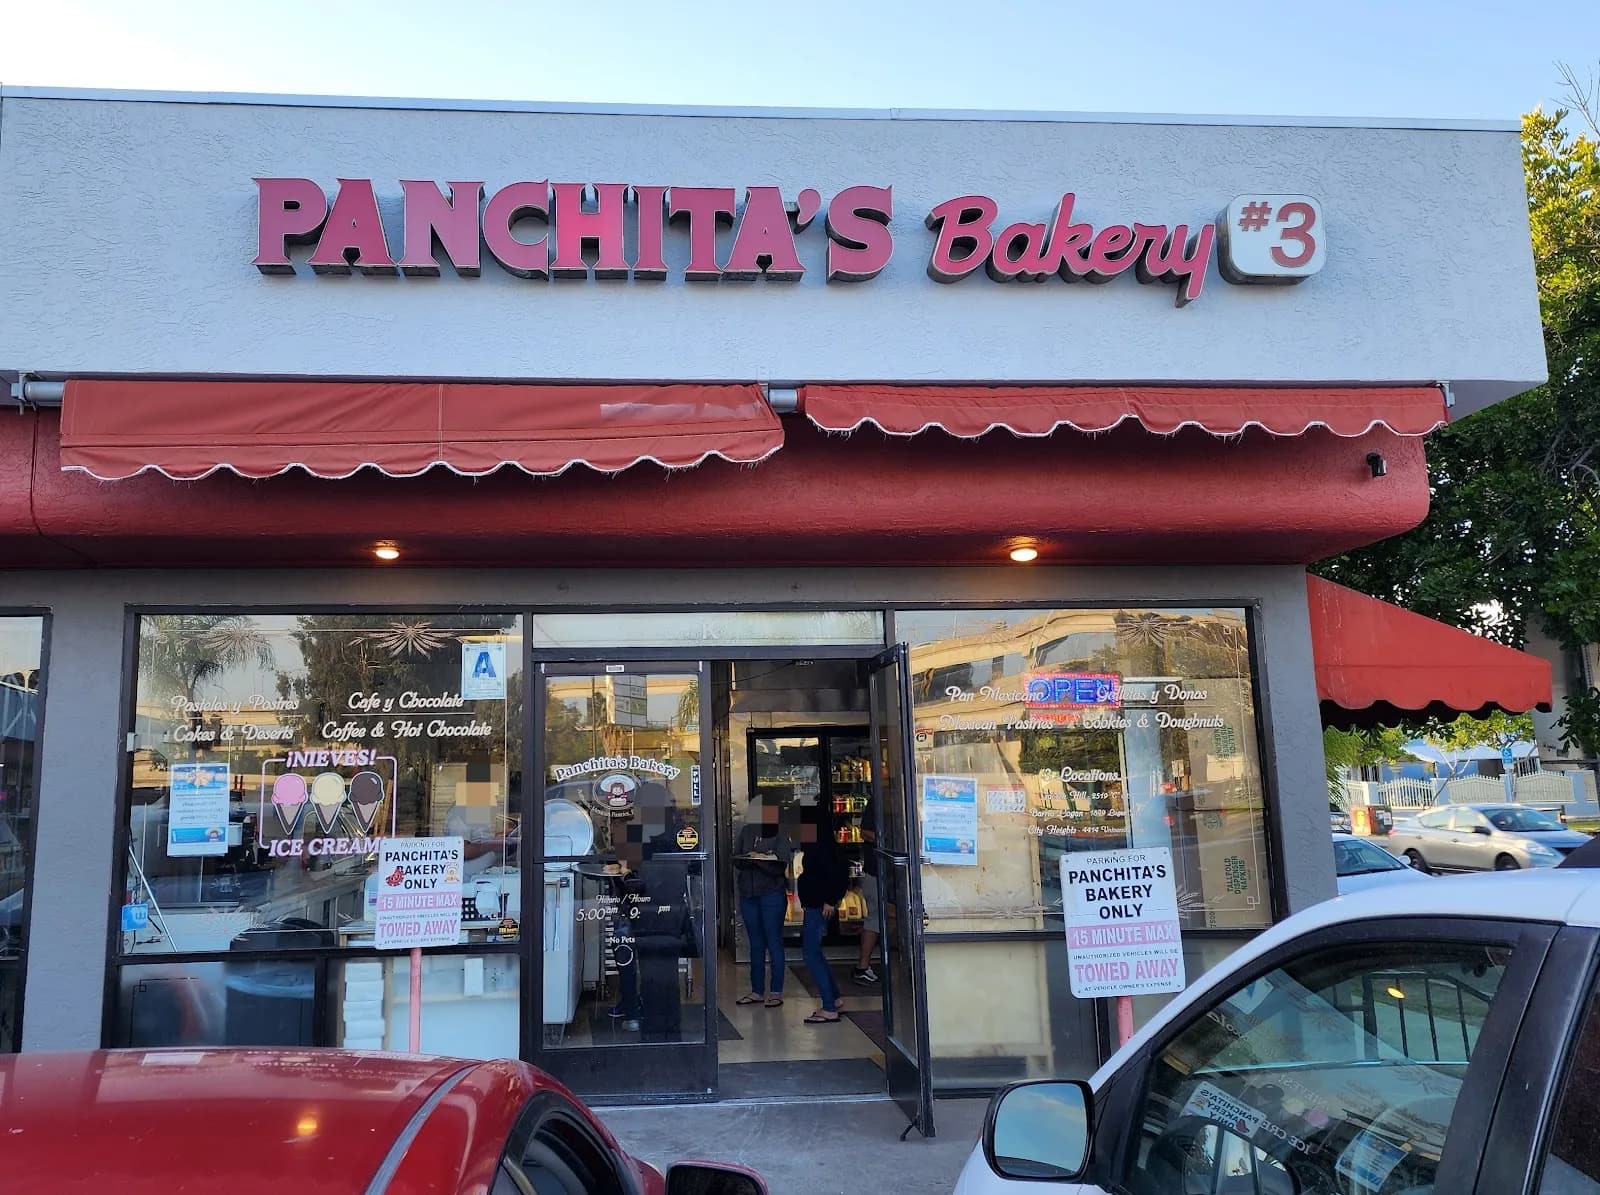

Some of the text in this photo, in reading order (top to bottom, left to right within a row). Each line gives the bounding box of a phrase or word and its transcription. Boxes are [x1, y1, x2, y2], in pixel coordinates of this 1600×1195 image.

[251, 178, 1318, 305] PANCHITA'S Bakery #3
[471, 651, 497, 679] A
[945, 685, 1045, 702] Pan Mexicano
[1029, 677, 1116, 703] OPEN
[1096, 684, 1208, 704] Galletas y Donas
[171, 694, 300, 715] Pasteles y Postres
[348, 691, 464, 713] Cafe y Chocolate
[322, 719, 492, 742] Coffee & Hot Chocolate
[940, 715, 997, 730] Mexican
[1083, 713, 1132, 729] Cookies
[1137, 713, 1149, 728] &
[1155, 712, 1225, 731] Doughnuts
[174, 725, 216, 742] Cakes
[220, 726, 235, 741] &
[286, 749, 377, 768] ¡NIEVES!
[555, 755, 681, 782] Panchita's Bakery
[1060, 766, 1121, 782] Locations
[1057, 809, 1084, 818] Logan
[1028, 825, 1045, 837] City
[1047, 825, 1077, 836] Heights
[268, 839, 305, 858] ICE
[385, 849, 459, 862] PANCHITA'S
[1086, 855, 1126, 865] PARKING
[404, 878, 438, 890] ONLY
[1069, 864, 1166, 885] PANCHITA'S
[382, 894, 457, 910] 15 MINUTE MAX
[628, 893, 651, 904] Hours
[1086, 884, 1153, 902] BAKERY
[576, 908, 605, 922] 5:00
[658, 905, 671, 915] pm
[1099, 903, 1143, 920] ONLY
[379, 919, 457, 938] TOWED AWAY
[1073, 924, 1175, 947] 15 MINUTE MAX
[1075, 958, 1179, 983] TOWED AWAY
